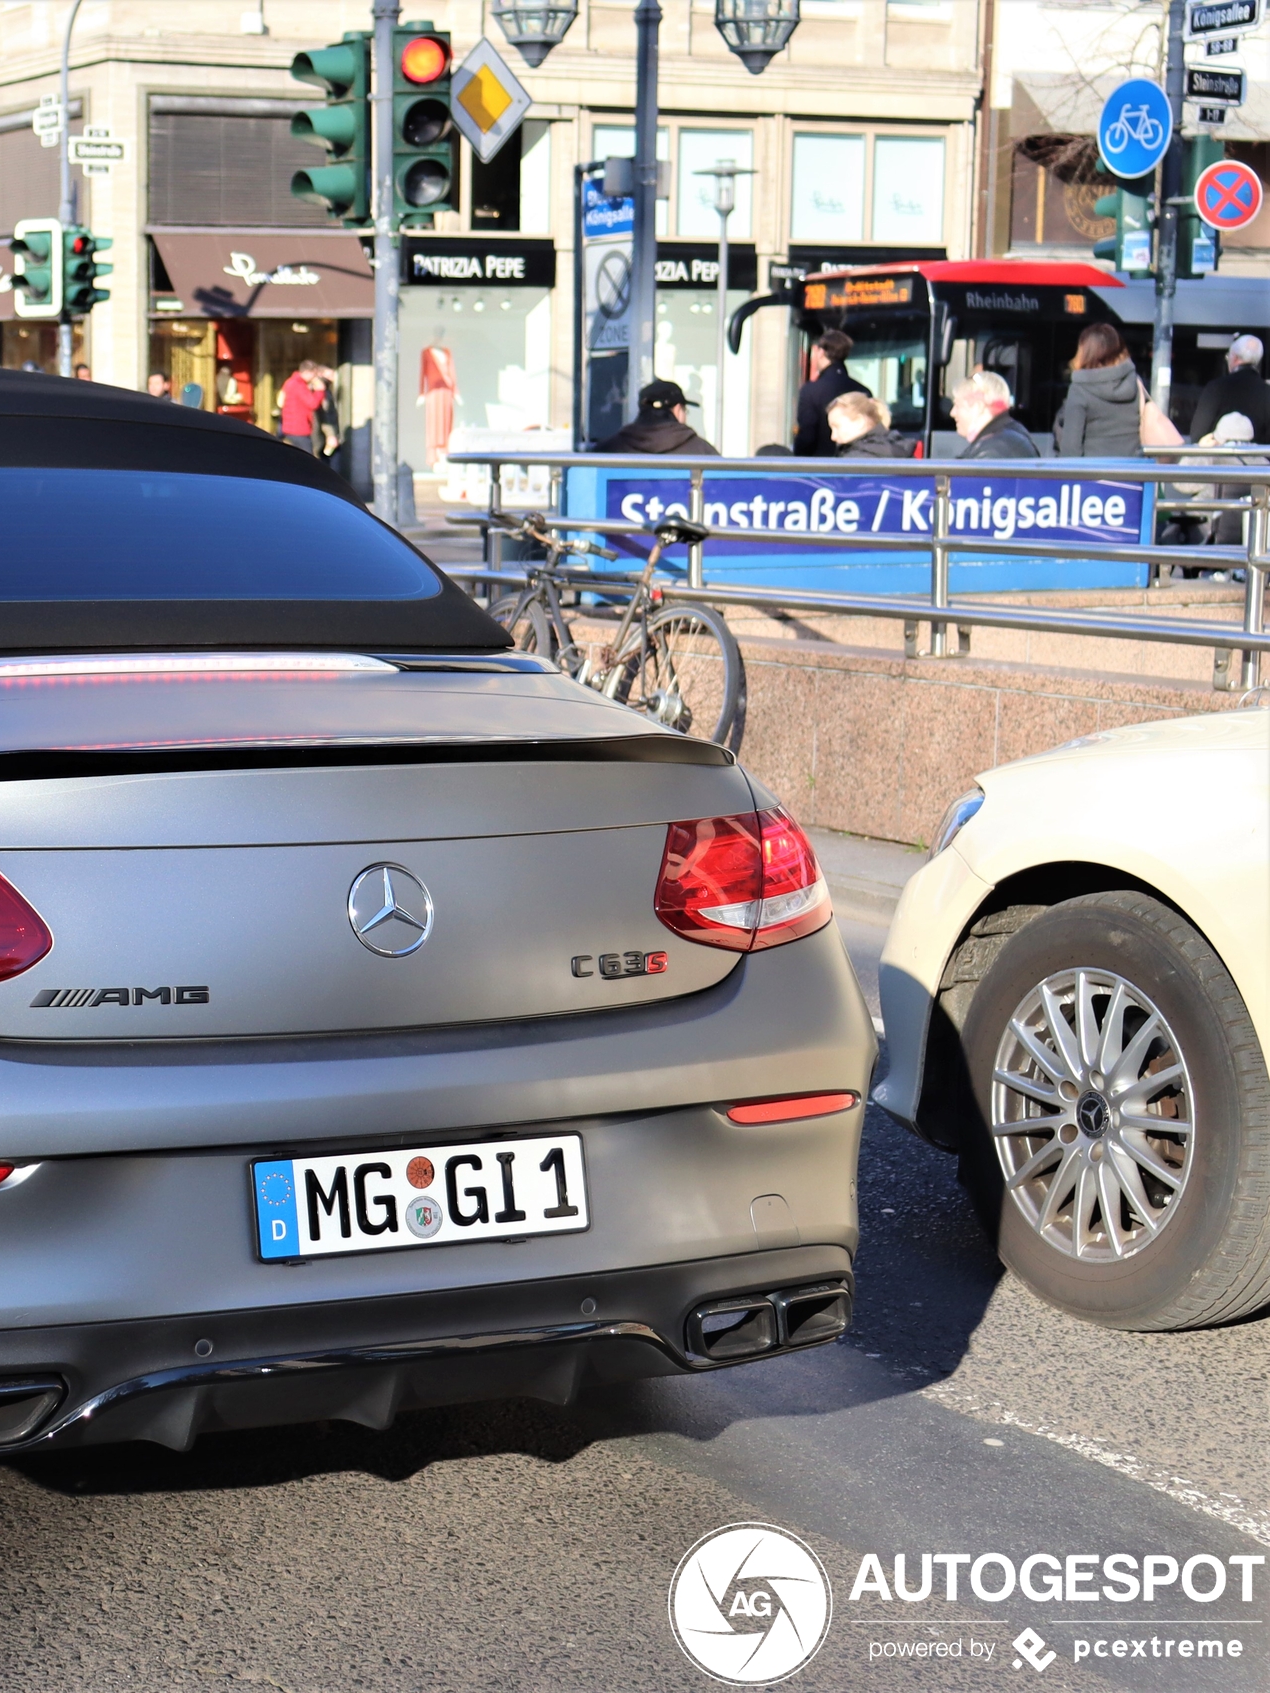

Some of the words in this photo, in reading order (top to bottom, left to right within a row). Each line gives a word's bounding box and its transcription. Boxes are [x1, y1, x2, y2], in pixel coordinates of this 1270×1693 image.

[1193, 3, 1251, 28] Königsallee
[1192, 72, 1240, 95] Steinstraße
[586, 204, 635, 228] Königsalle
[413, 253, 483, 278] PATRIZIA
[485, 254, 525, 279] PEPE
[691, 259, 720, 282] PEP
[965, 291, 1040, 312] Rheinbahn
[599, 323, 629, 342] ZONE
[621, 487, 860, 533] Stnstraße
[871, 489, 890, 532] /
[88, 985, 210, 1008] AMG
[304, 1162, 399, 1242] MG
[444, 1154, 527, 1226] GI
[539, 1147, 579, 1219] 1
[271, 1219, 287, 1241] D
